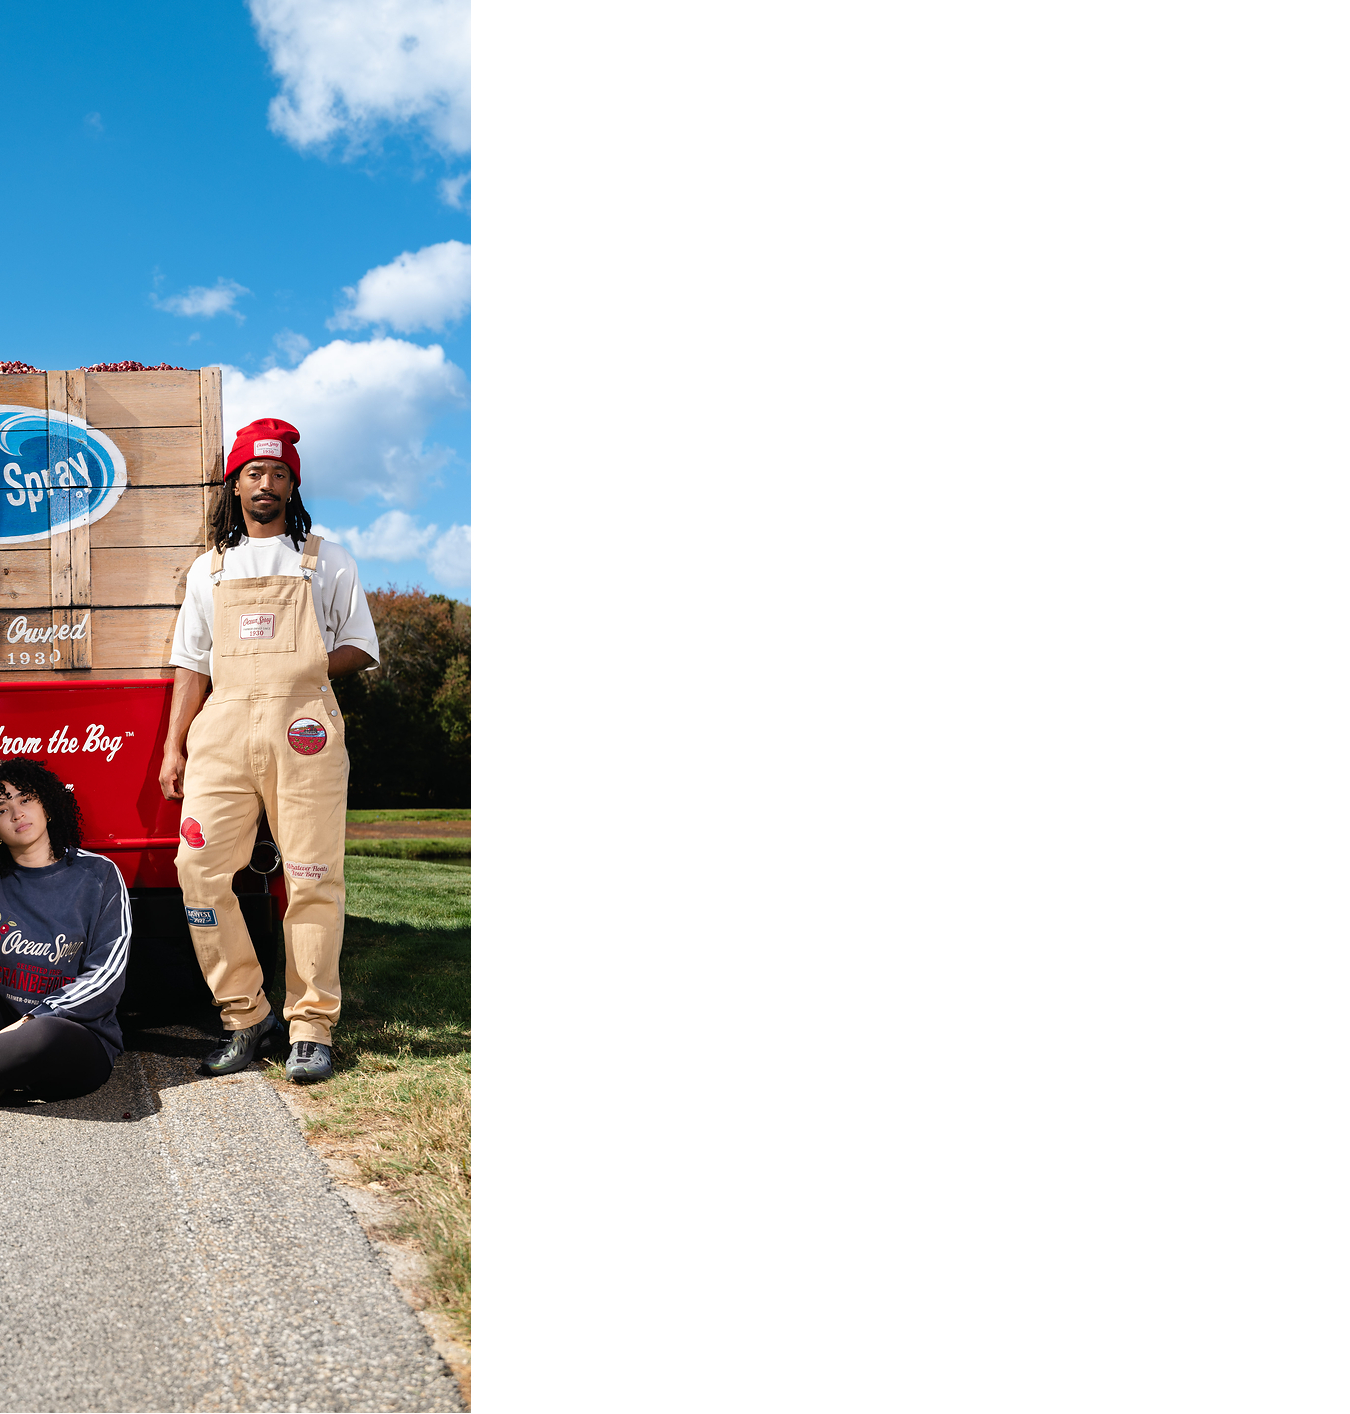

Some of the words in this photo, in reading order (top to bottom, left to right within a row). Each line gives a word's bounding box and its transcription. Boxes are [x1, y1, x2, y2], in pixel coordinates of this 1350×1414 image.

[3, 451, 93, 513] Spray
[6, 613, 90, 644] Owned
[7, 649, 61, 666] 1930
[47, 725, 80, 754] the
[1, 930, 51, 956] Ocean
[16, 962, 48, 975] SELECTED
